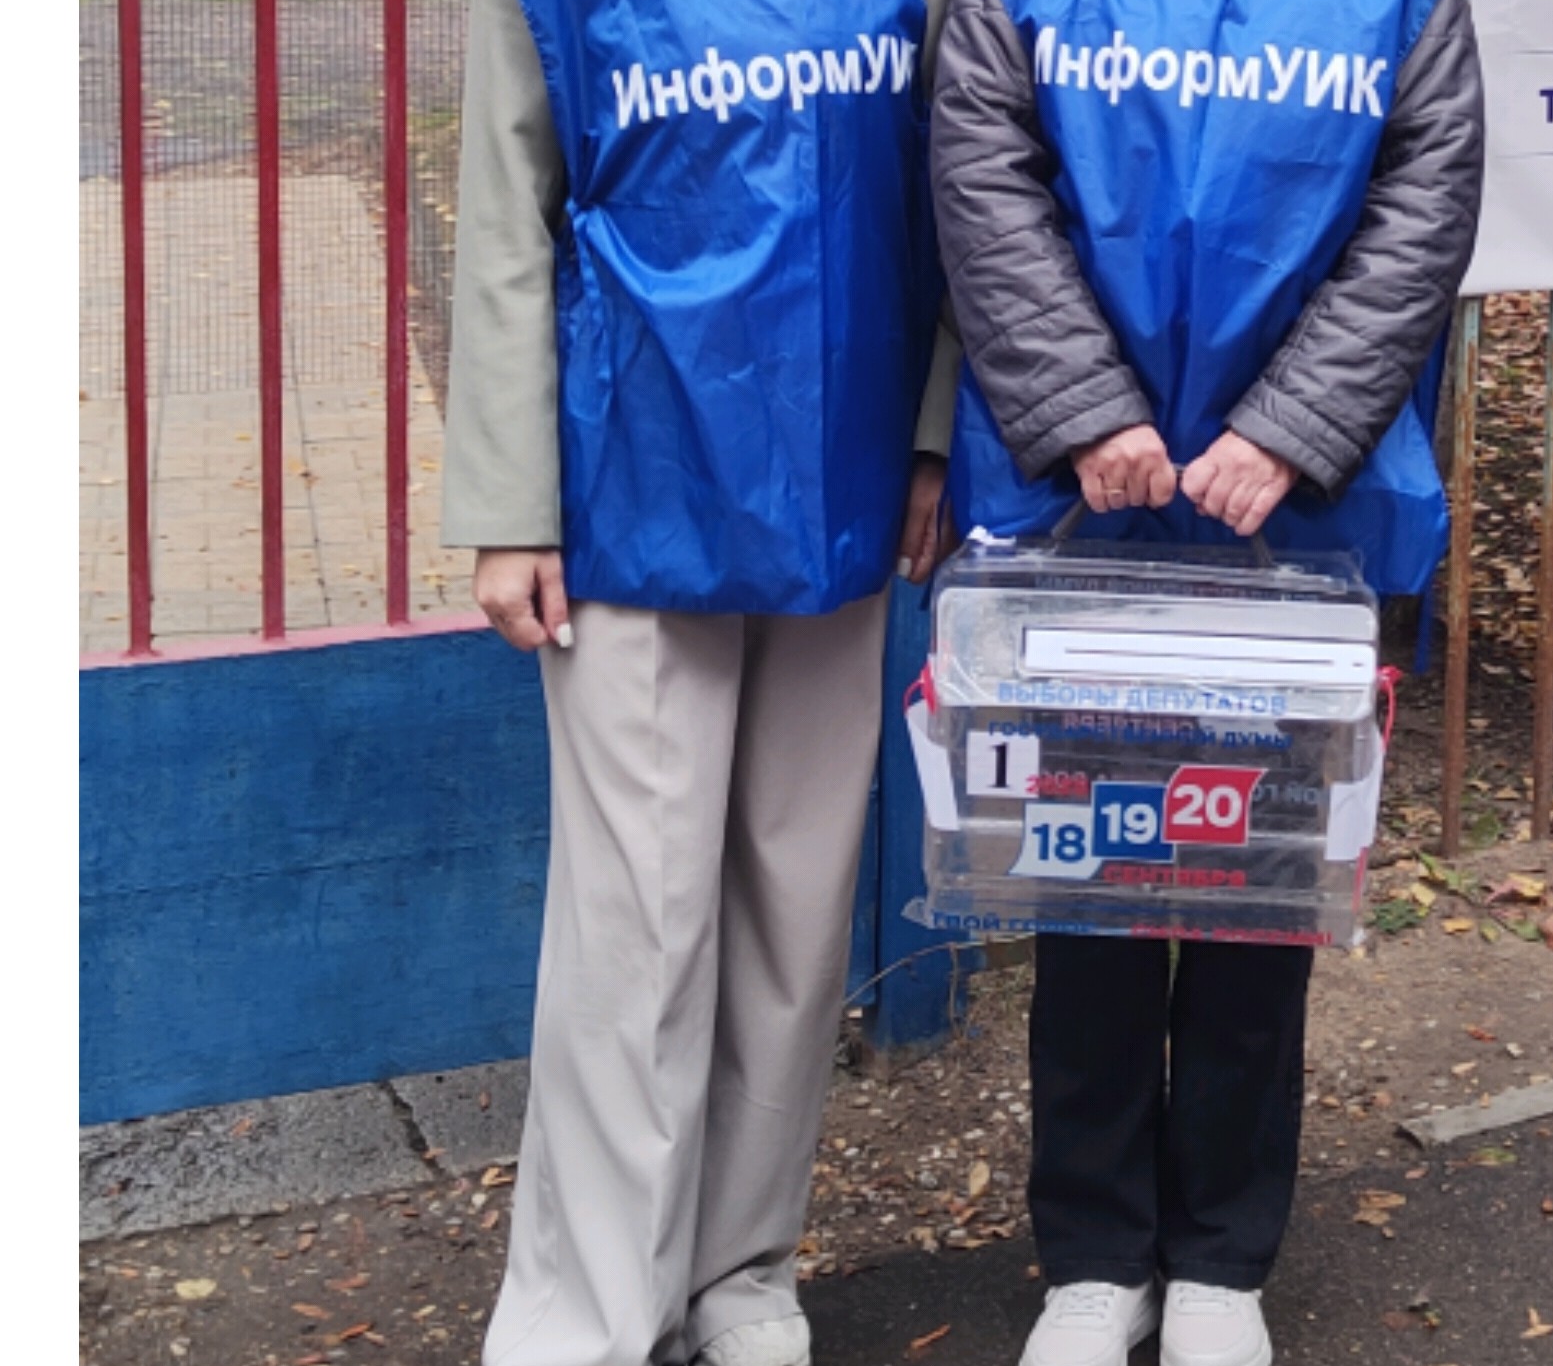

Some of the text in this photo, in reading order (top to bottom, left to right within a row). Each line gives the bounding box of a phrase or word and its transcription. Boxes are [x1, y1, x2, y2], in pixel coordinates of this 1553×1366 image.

[612, 33, 917, 130] ИнформУИ
[1035, 26, 1387, 117] ИнформУИК
[999, 682, 1118, 706] ВЫБОРЫ
[992, 742, 1008, 789] 1
[1032, 823, 1086, 862] 18
[1100, 803, 1158, 844] 19
[1171, 785, 1241, 828] 20
